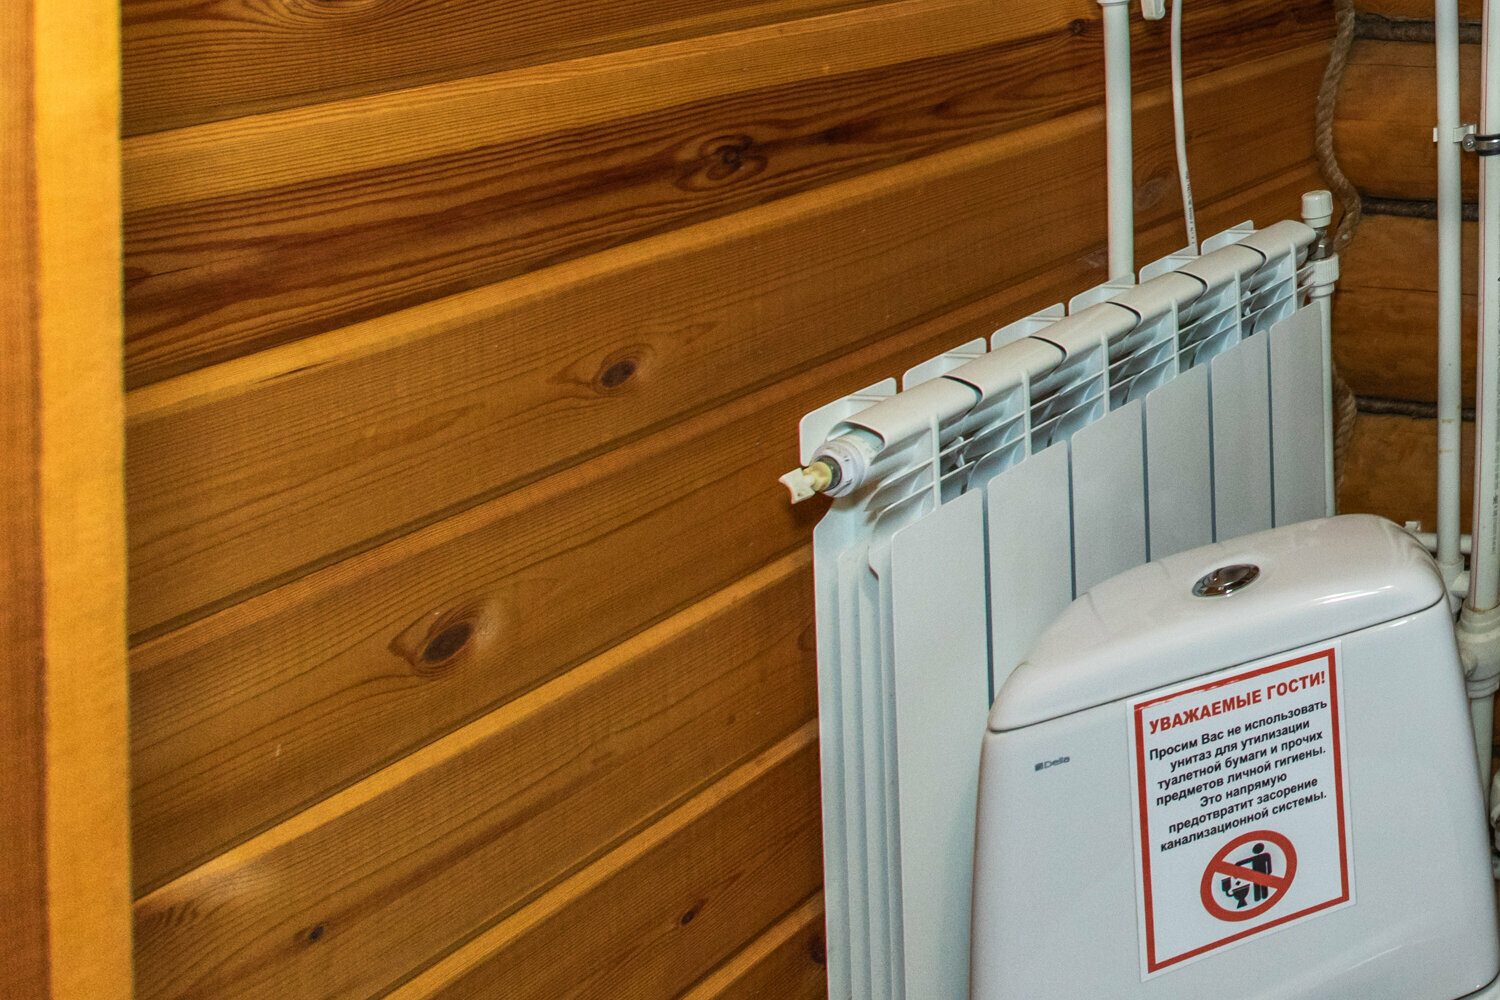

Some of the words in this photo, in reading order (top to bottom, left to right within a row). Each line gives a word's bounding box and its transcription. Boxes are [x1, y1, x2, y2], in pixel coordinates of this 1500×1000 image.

[1149, 689, 1262, 734] УВАЖАЕМЫЕ
[1267, 670, 1326, 700] ГОСТИ!
[1149, 738, 1198, 760] Просим
[1201, 731, 1224, 745] Вас
[1227, 726, 1241, 737] не
[1245, 700, 1327, 731] использовать
[1156, 777, 1224, 806] предметов
[1227, 761, 1272, 784] личной
[1274, 746, 1326, 769] гигиены.
[1157, 761, 1222, 791] туалетной
[1225, 747, 1267, 769] бумаги
[1270, 744, 1278, 755] и
[1281, 730, 1323, 753] прочих
[1170, 750, 1212, 773] унитаз
[1215, 742, 1238, 758] для
[1240, 720, 1310, 751] утилизации
[1168, 798, 1254, 834] предотвратит
[1257, 778, 1318, 805] засорение
[1200, 793, 1222, 807] Это
[1225, 772, 1288, 800] напрямую
[1160, 806, 1269, 852] канализационной
[1272, 790, 1327, 815] системы.
